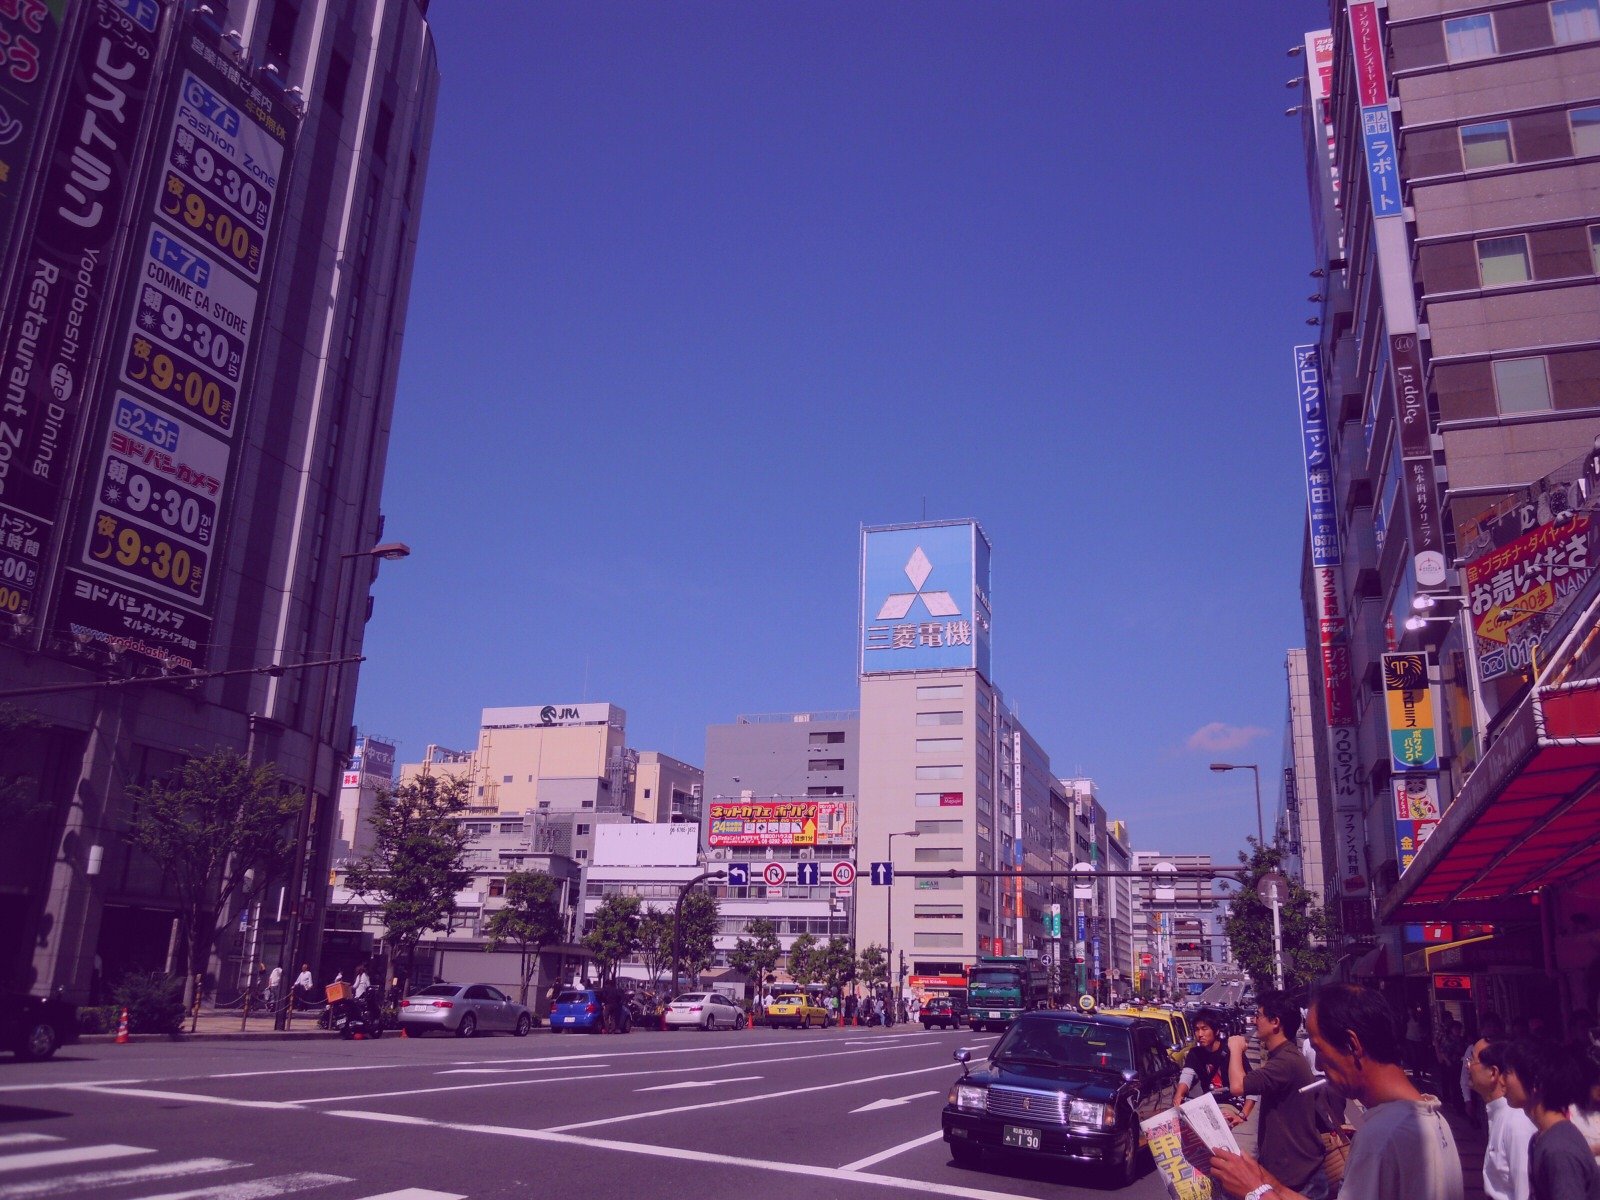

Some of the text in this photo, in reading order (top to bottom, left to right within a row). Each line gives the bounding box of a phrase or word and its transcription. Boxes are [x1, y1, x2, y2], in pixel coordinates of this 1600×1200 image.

[191, 36, 273, 113] 営業時間ご案内
[178, 106, 277, 189] Fashion Zone
[245, 98, 286, 141] 年中無休
[176, 127, 268, 226] 朝 9:30 から
[1371, 140, 1394, 210] ラポート
[167, 174, 186, 199] 夜
[182, 193, 249, 259] 9:00
[143, 286, 240, 377] 朝 9:30 から
[147, 261, 194, 302] COMME
[213, 302, 248, 336] STORE
[4, 258, 60, 418] Restaurant
[134, 337, 153, 361] 夜
[150, 354, 220, 416] 9:00
[33, 402, 65, 479] Dining
[110, 430, 220, 496] ヨドバシカメラ
[0, 513, 38, 536] トラン
[108, 458, 212, 541] 朝 9:30 から
[97, 514, 117, 539] 夜
[115, 528, 190, 586] 9:30
[74, 579, 185, 629] ヨドバシカメラ
[865, 620, 972, 650] 三菱電機
[557, 707, 580, 719] JRA
[711, 803, 817, 819] ネットカフェ ポパイ
[1344, 814, 1359, 876] フランス料理
[837, 868, 850, 879] 40
